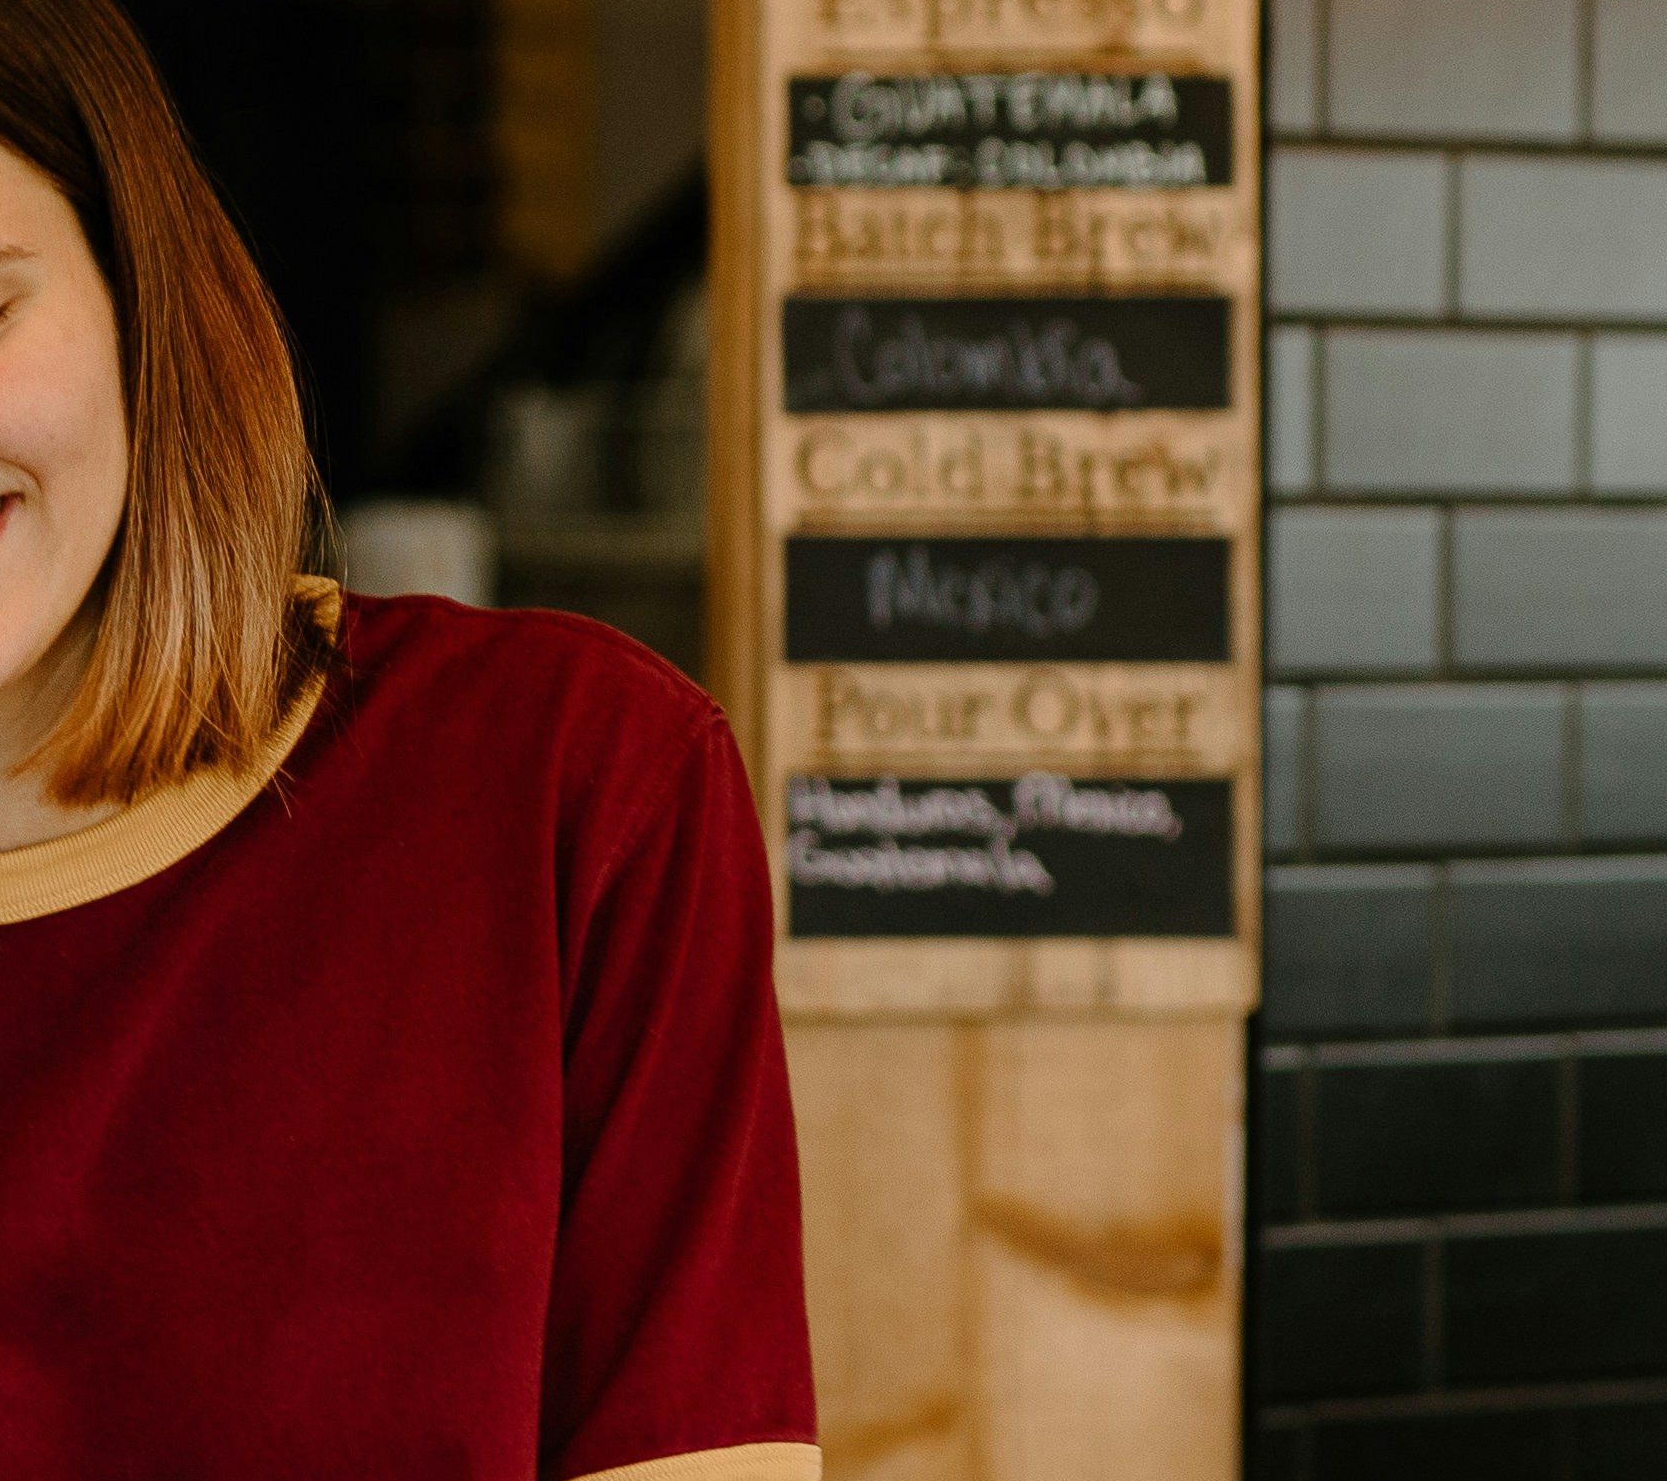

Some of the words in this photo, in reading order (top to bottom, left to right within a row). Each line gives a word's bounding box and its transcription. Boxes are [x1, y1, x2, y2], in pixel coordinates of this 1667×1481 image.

[794, 197, 1005, 261] Batch
[1034, 197, 1224, 261] Brew
[792, 425, 980, 499] Cold
[1018, 429, 1224, 499] Brew
[816, 669, 996, 743] Pour
[1010, 669, 1202, 745] Over
